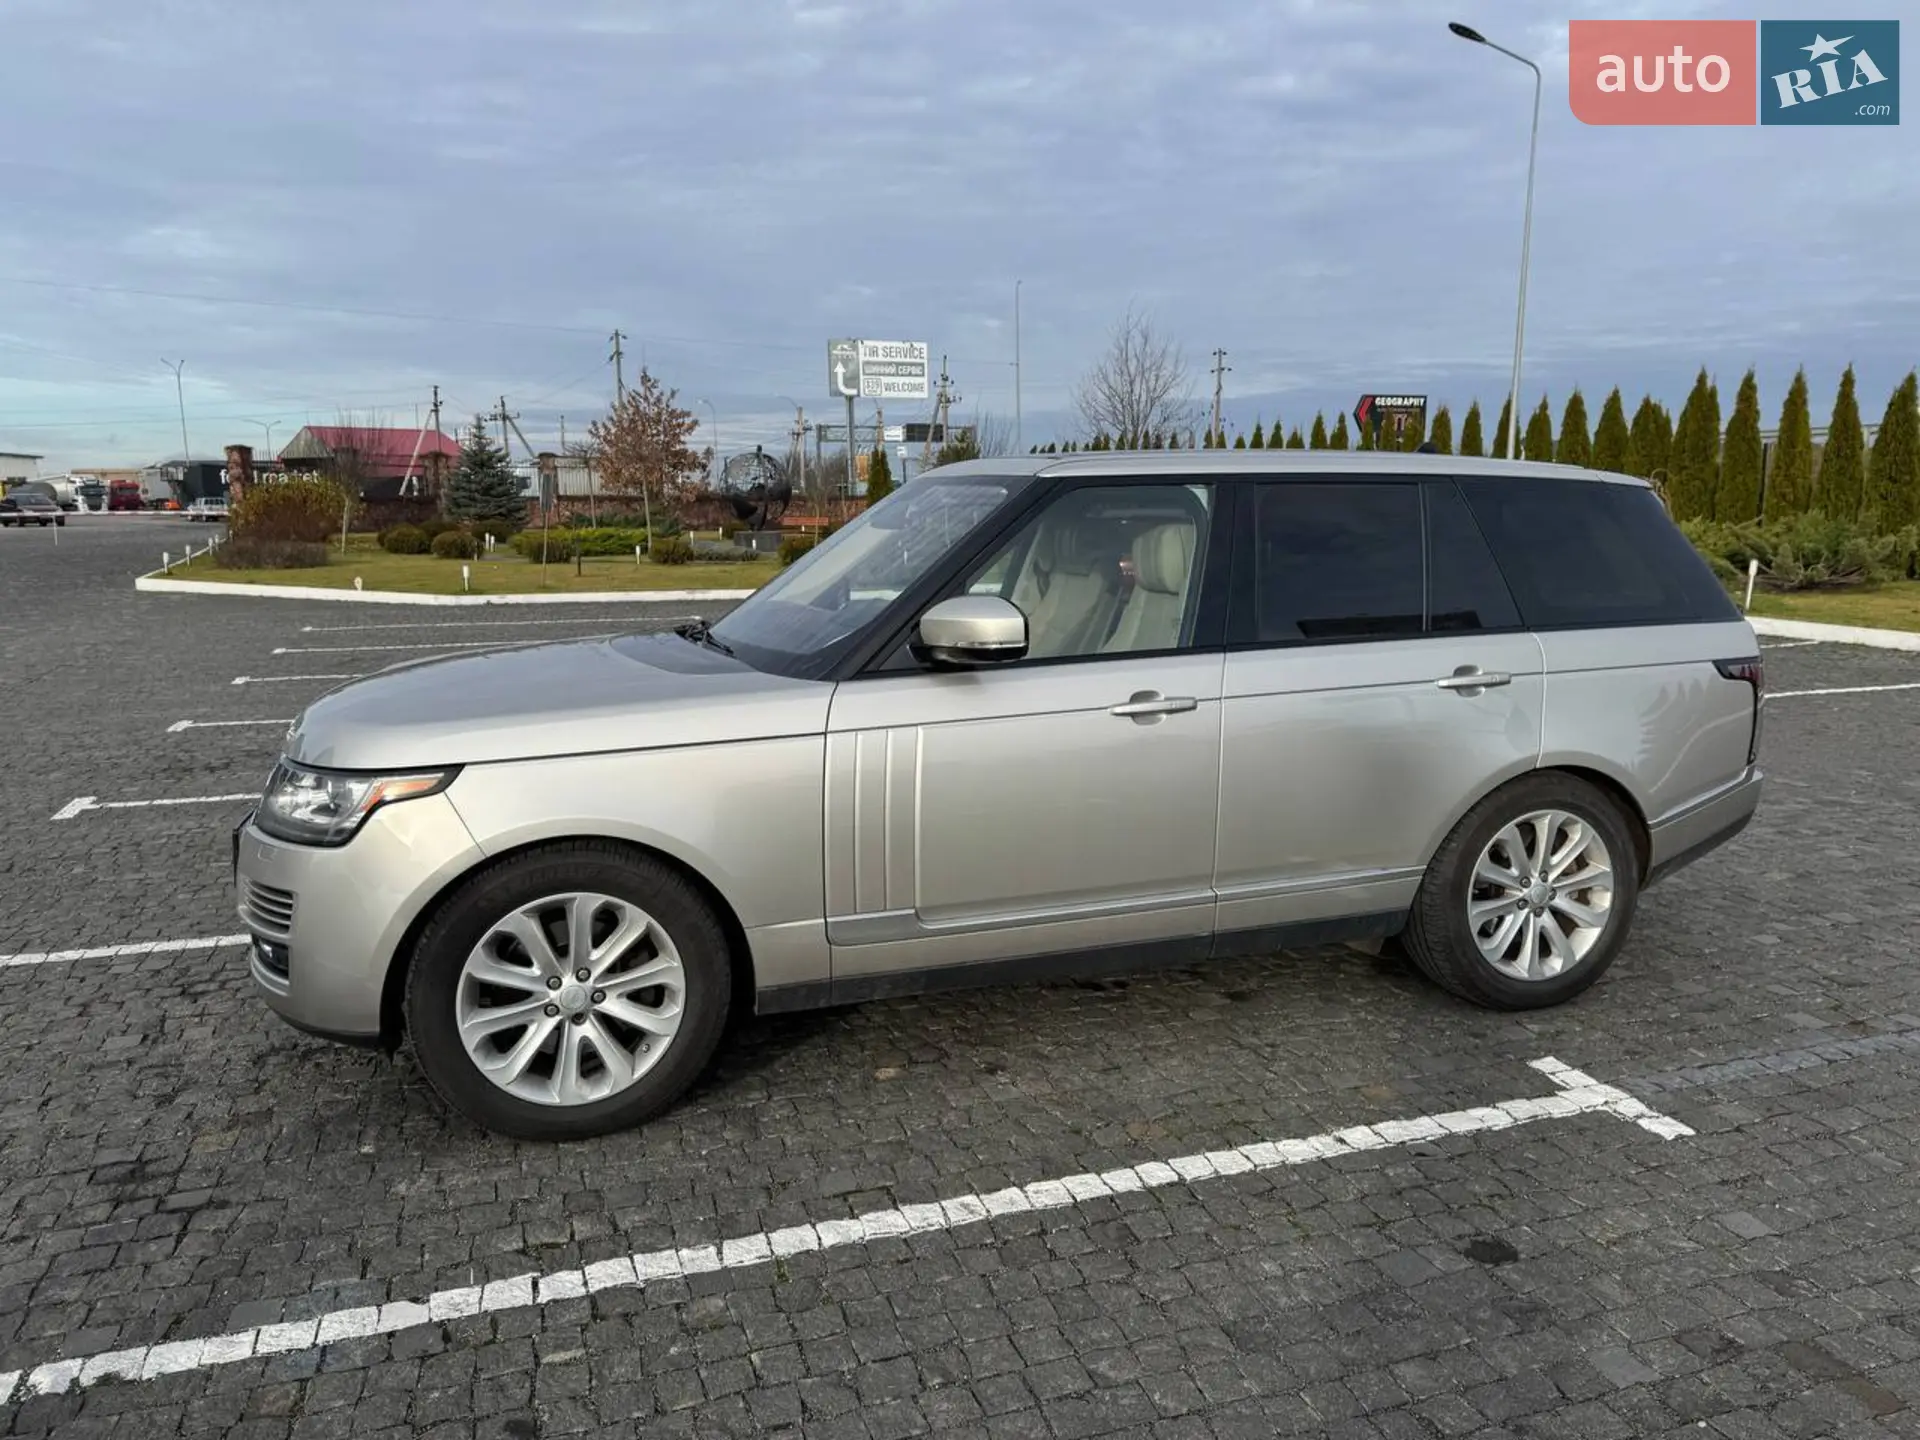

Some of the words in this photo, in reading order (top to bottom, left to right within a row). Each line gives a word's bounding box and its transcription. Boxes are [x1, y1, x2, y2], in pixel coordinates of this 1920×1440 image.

[882, 346, 925, 359] SERVICE
[883, 382, 925, 392] WELCOME
[1375, 396, 1425, 406] GEOGRAPHY
